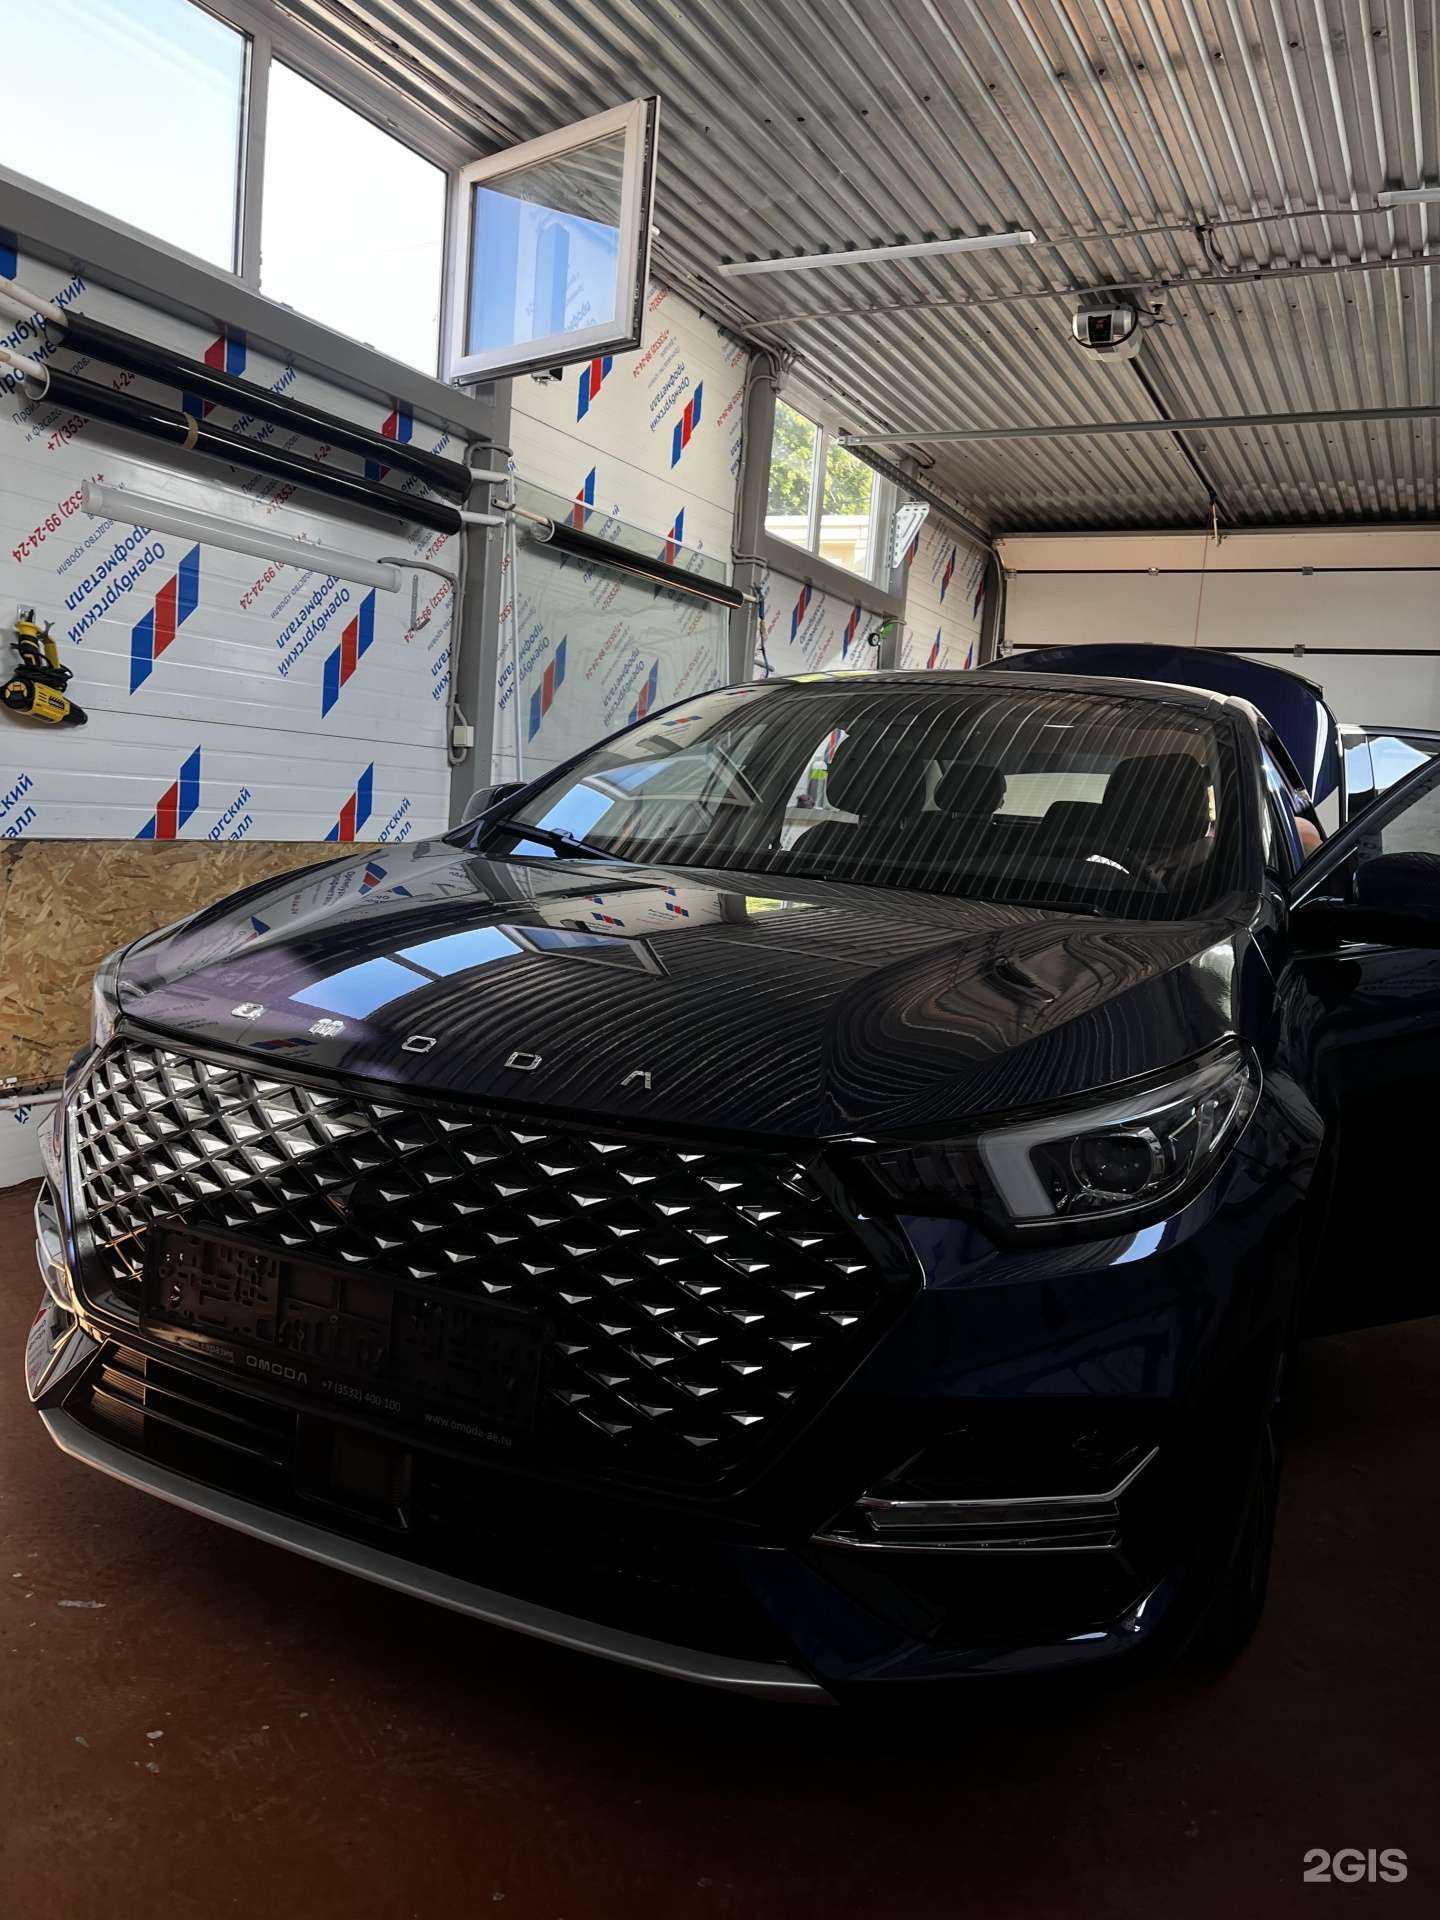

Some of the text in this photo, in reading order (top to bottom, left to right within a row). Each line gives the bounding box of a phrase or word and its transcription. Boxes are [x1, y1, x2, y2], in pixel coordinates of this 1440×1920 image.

[12, 511, 63, 564] 99-24-24
[67, 541, 166, 645] Оренбургский
[239, 567, 277, 610] 99-24-24
[277, 587, 351, 678] Оренбургский
[245, 1354, 309, 1385] OMODA
